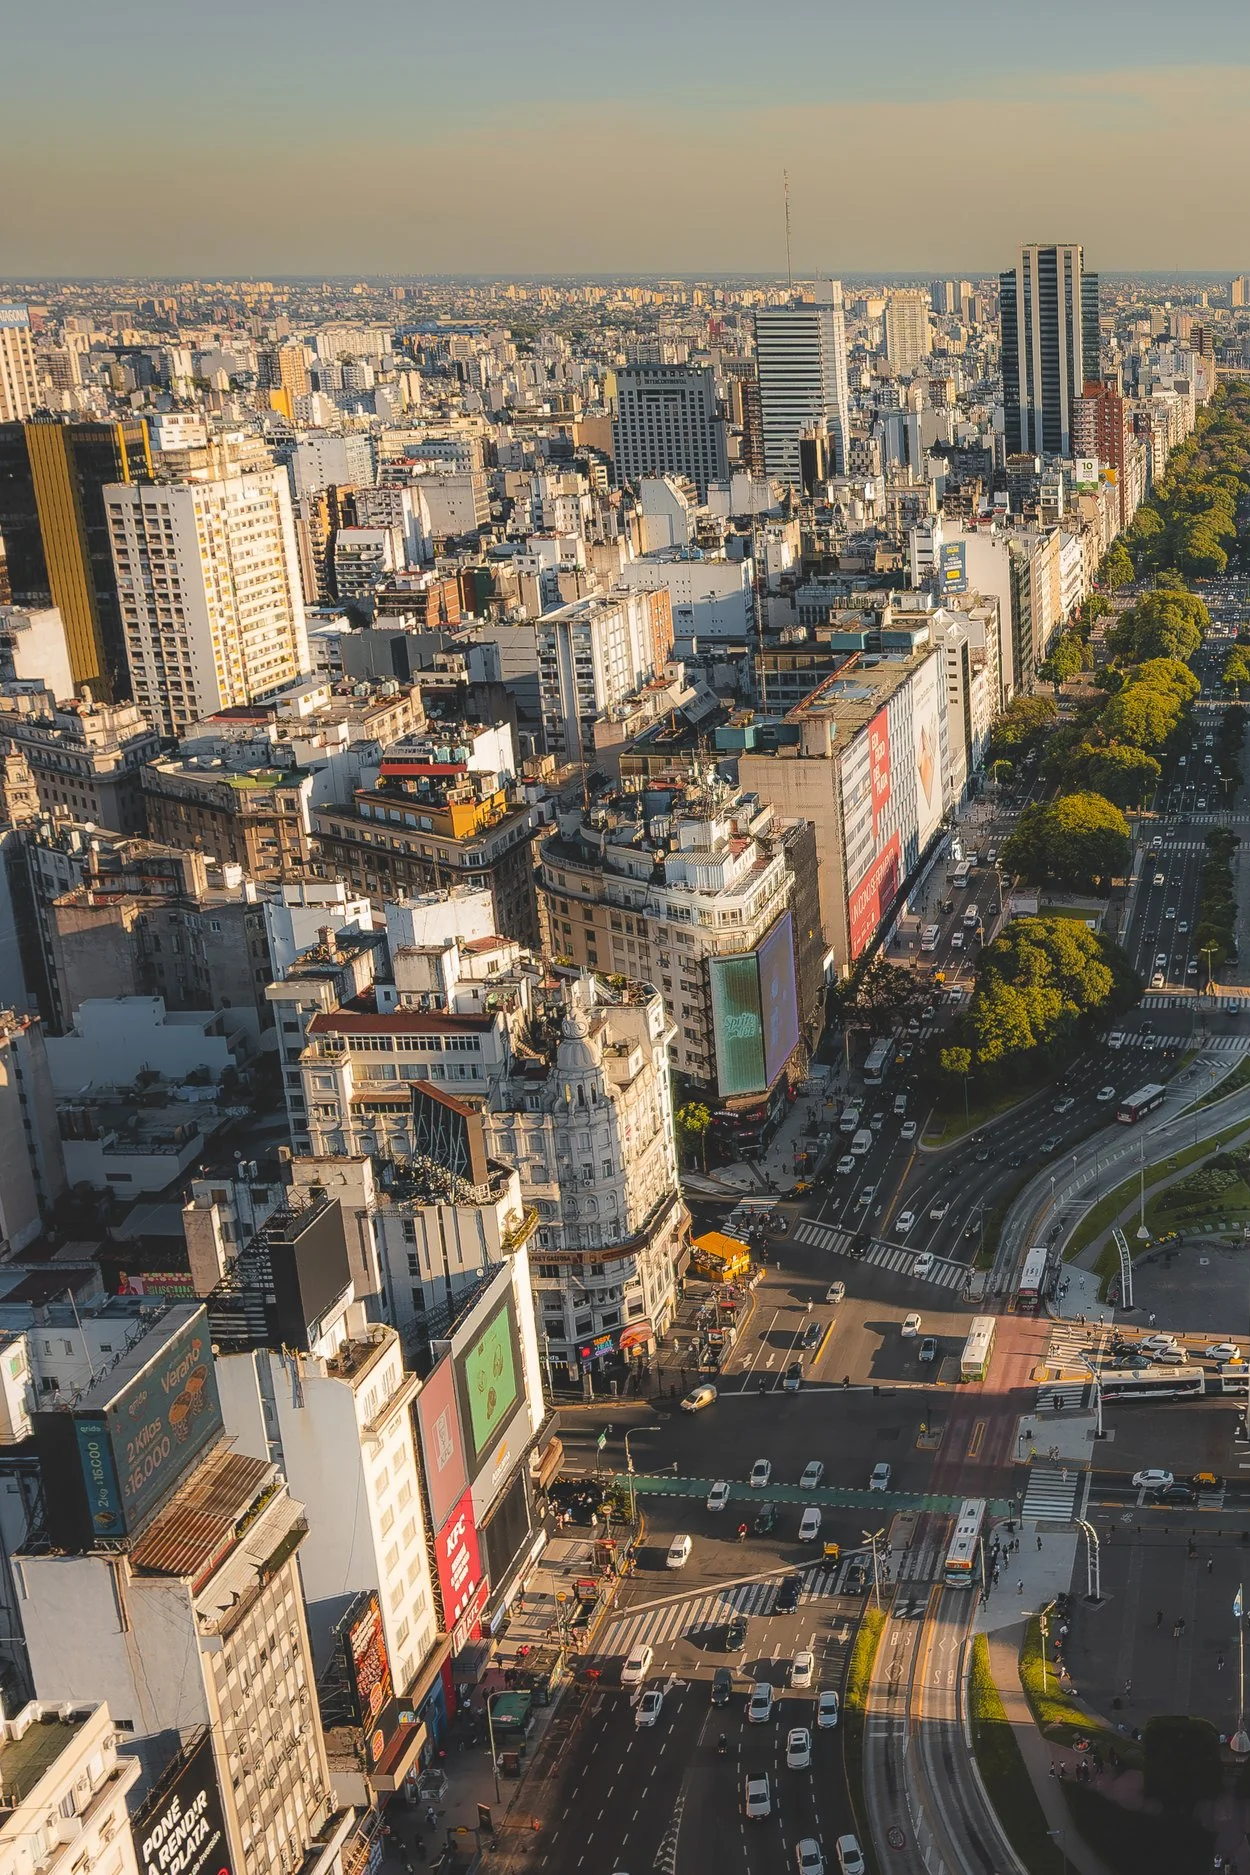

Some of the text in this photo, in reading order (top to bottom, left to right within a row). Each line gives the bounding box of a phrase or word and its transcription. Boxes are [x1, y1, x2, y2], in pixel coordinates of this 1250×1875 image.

[1081, 462, 1093, 470] 10
[724, 1013, 756, 1031] Sprite
[161, 1347, 200, 1394] Verano
[124, 1436, 170, 1497] $16.000
[127, 1442, 136, 1463] 2
[446, 1512, 466, 1558] KFC
[466, 1599, 479, 1627] KFC
[142, 1794, 182, 1863] PONÉ
[170, 1817, 210, 1875] PLATA
